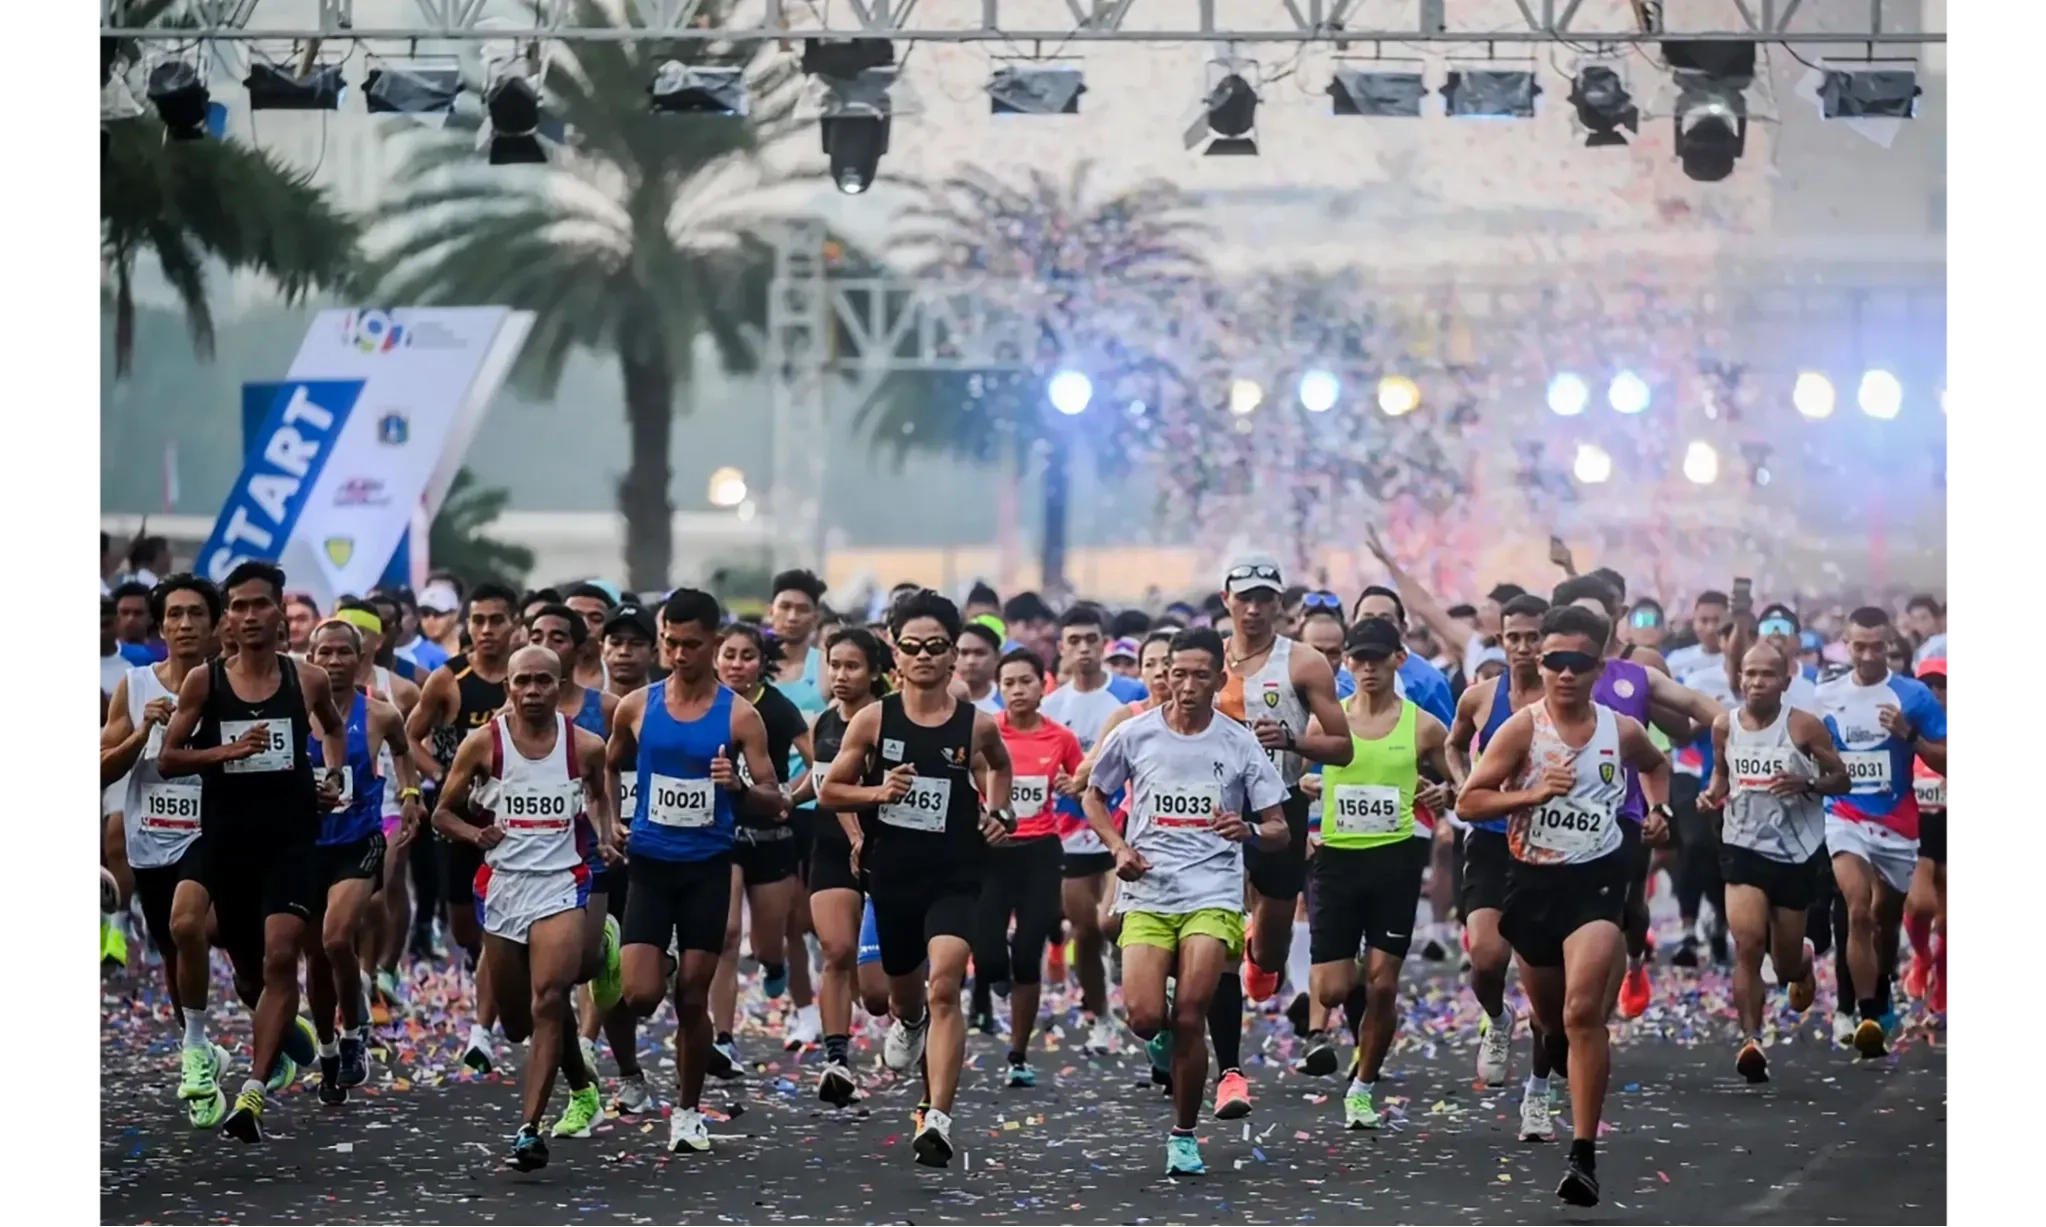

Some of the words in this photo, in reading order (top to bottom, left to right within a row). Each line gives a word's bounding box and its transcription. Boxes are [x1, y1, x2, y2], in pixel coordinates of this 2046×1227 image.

[1735, 759, 1783, 775] 19045
[149, 796, 198, 816] 19581
[505, 796, 564, 815] 19580
[658, 788, 706, 808] 10021
[893, 790, 942, 811] 463
[1154, 794, 1211, 814] 19033
[1339, 799, 1394, 816] 15645
[1540, 807, 1601, 831] 10462
